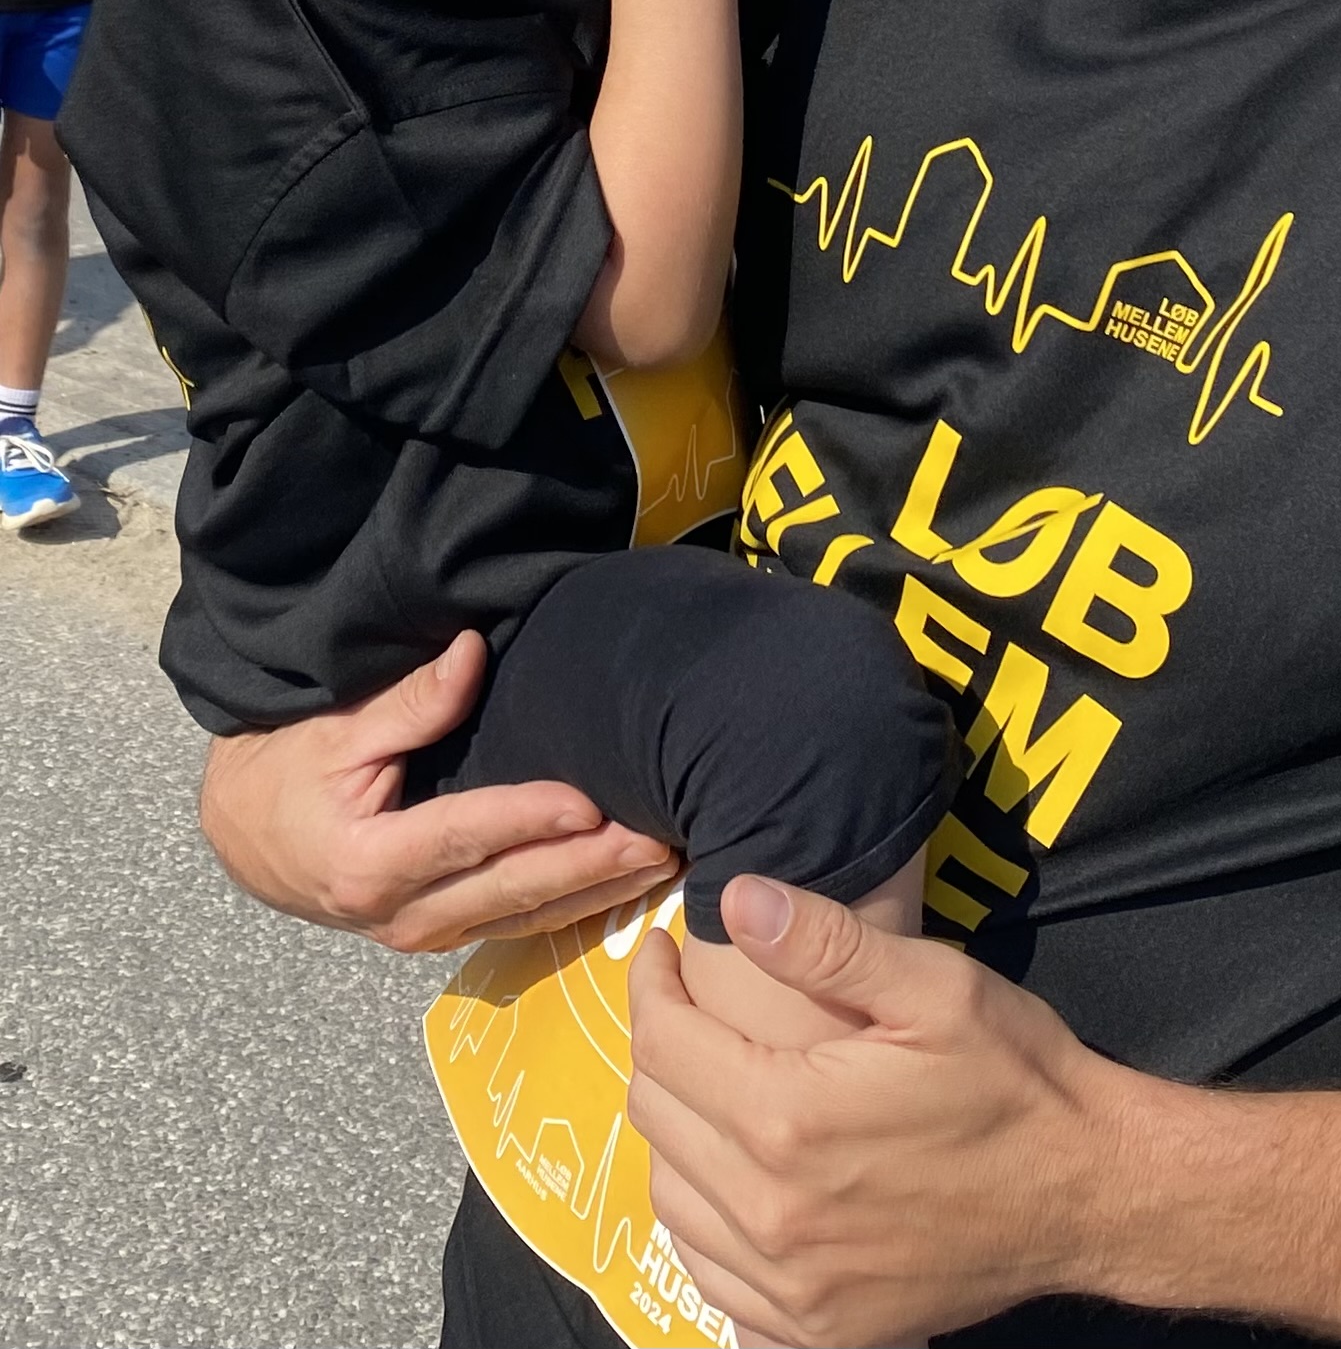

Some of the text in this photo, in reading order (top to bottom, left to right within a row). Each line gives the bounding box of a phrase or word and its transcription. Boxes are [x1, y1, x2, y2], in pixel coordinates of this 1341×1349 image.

[1159, 297, 1199, 327] LØB
[1105, 318, 1180, 362] HUSENE
[890, 418, 1193, 679] LØB
[629, 1281, 672, 1335] 2024
